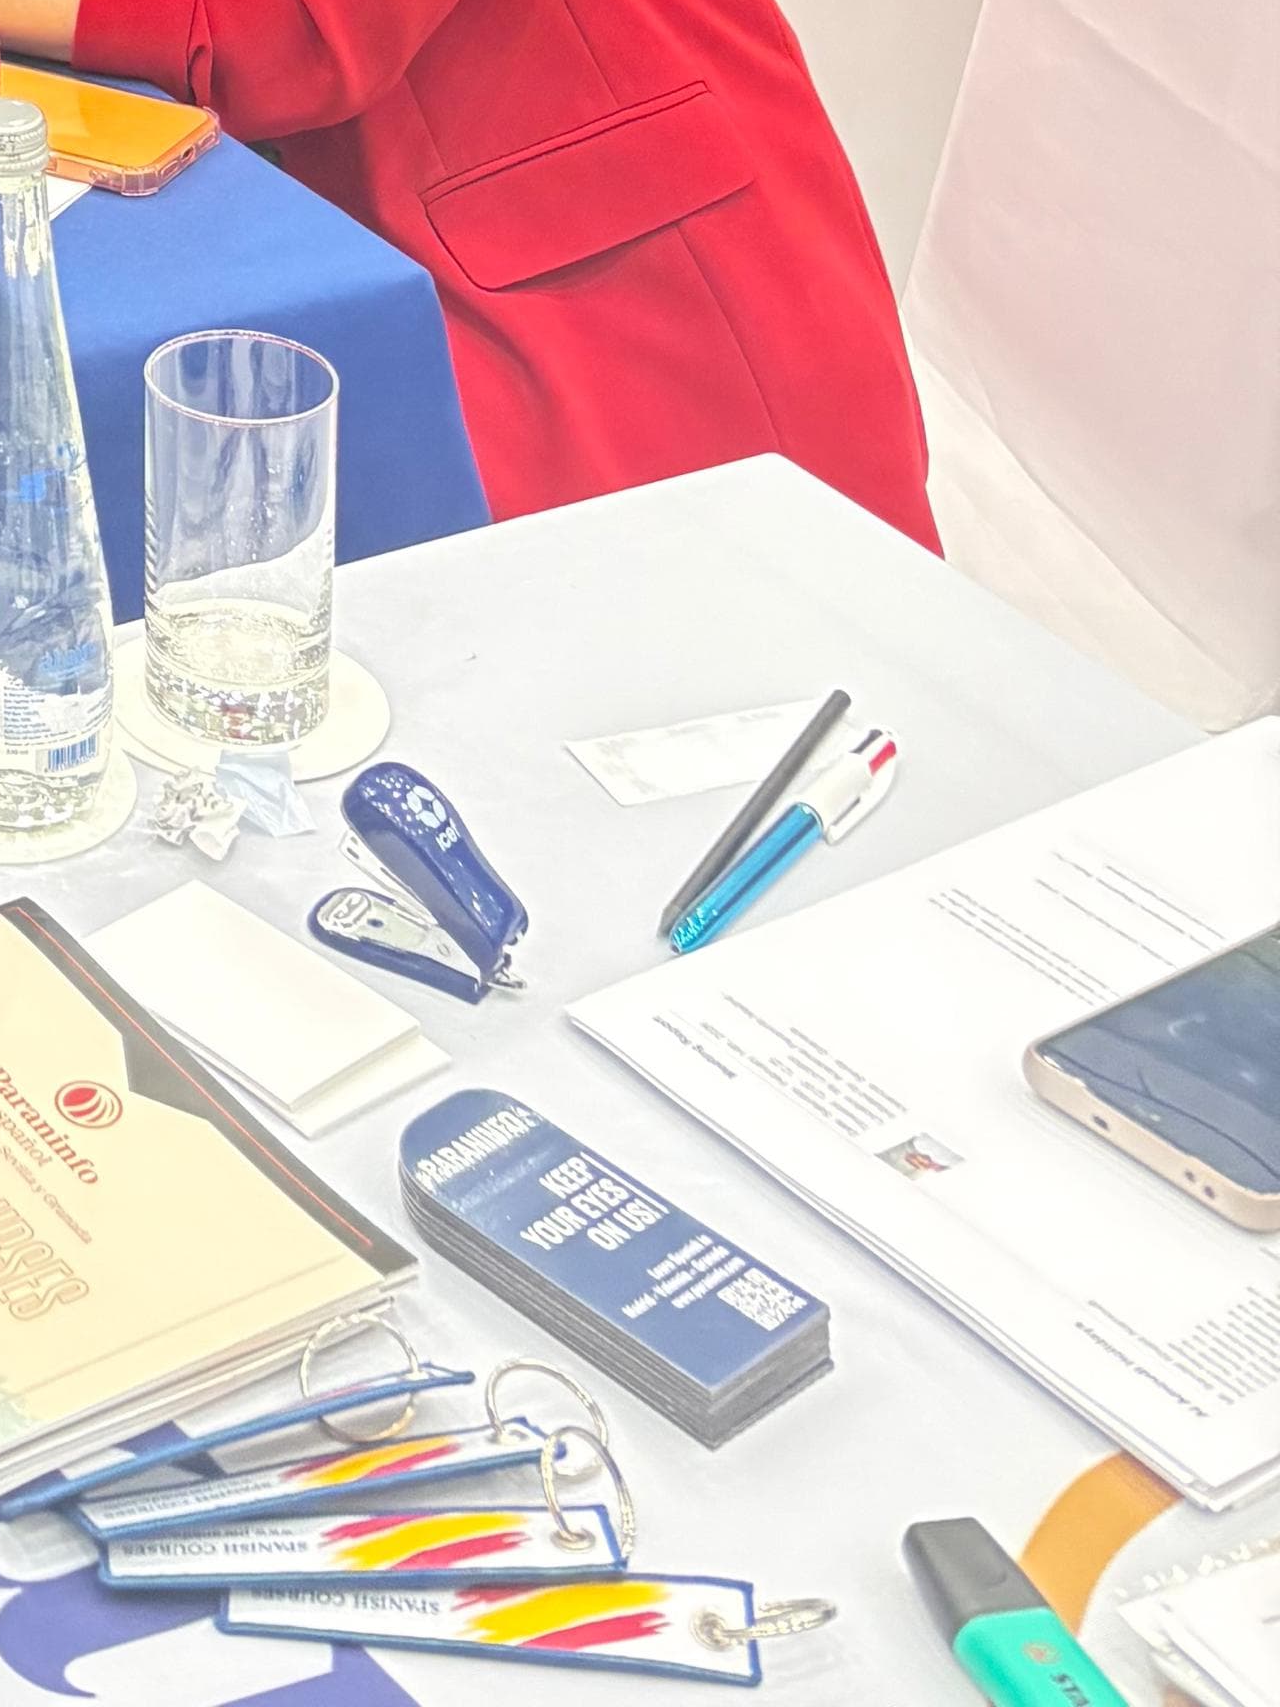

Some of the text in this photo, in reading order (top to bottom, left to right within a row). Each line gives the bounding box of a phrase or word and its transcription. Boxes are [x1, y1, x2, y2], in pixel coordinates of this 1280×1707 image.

[435, 816, 461, 853] icef
[539, 1156, 595, 1200] KEEP
[43, 1192, 93, 1245] Granada
[520, 1206, 588, 1251] YOUR
[570, 1177, 630, 1220] EYES
[586, 1197, 664, 1251] ON US!
[122, 1539, 309, 1558] SPANISH COURSES
[353, 1592, 440, 1617] SPANISH
